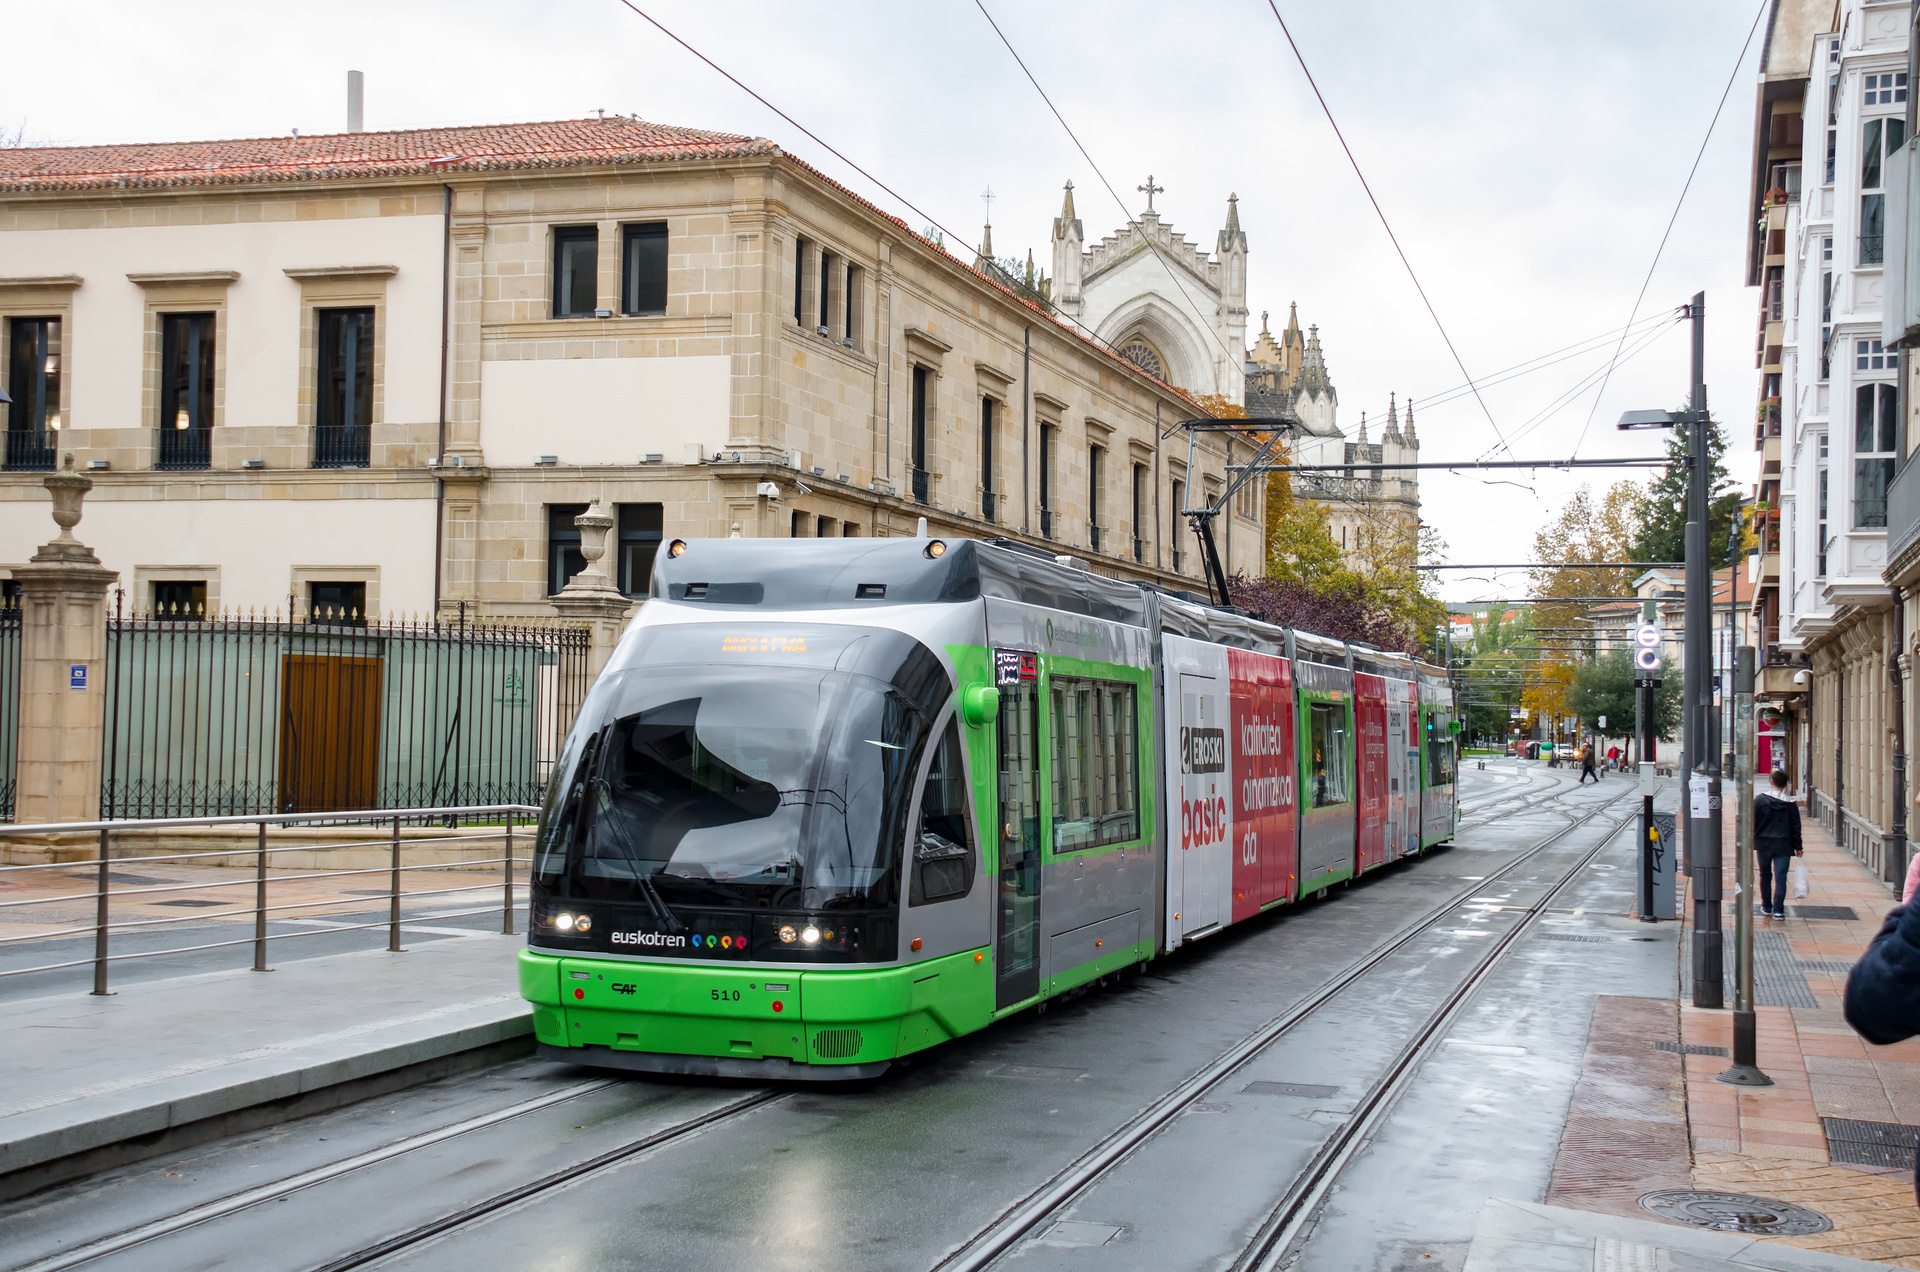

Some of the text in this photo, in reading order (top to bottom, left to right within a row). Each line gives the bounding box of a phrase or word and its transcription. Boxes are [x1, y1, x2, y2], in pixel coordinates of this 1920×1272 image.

[1193, 736, 1223, 765] EROSKI
[1241, 714, 1281, 756] kalitatea
[1242, 767, 1292, 812] oinarrizkoa
[1181, 783, 1226, 850] basic
[1242, 823, 1257, 866] da
[611, 930, 686, 947] euskotren
[611, 983, 637, 995] CAF
[711, 989, 740, 1001] 510
